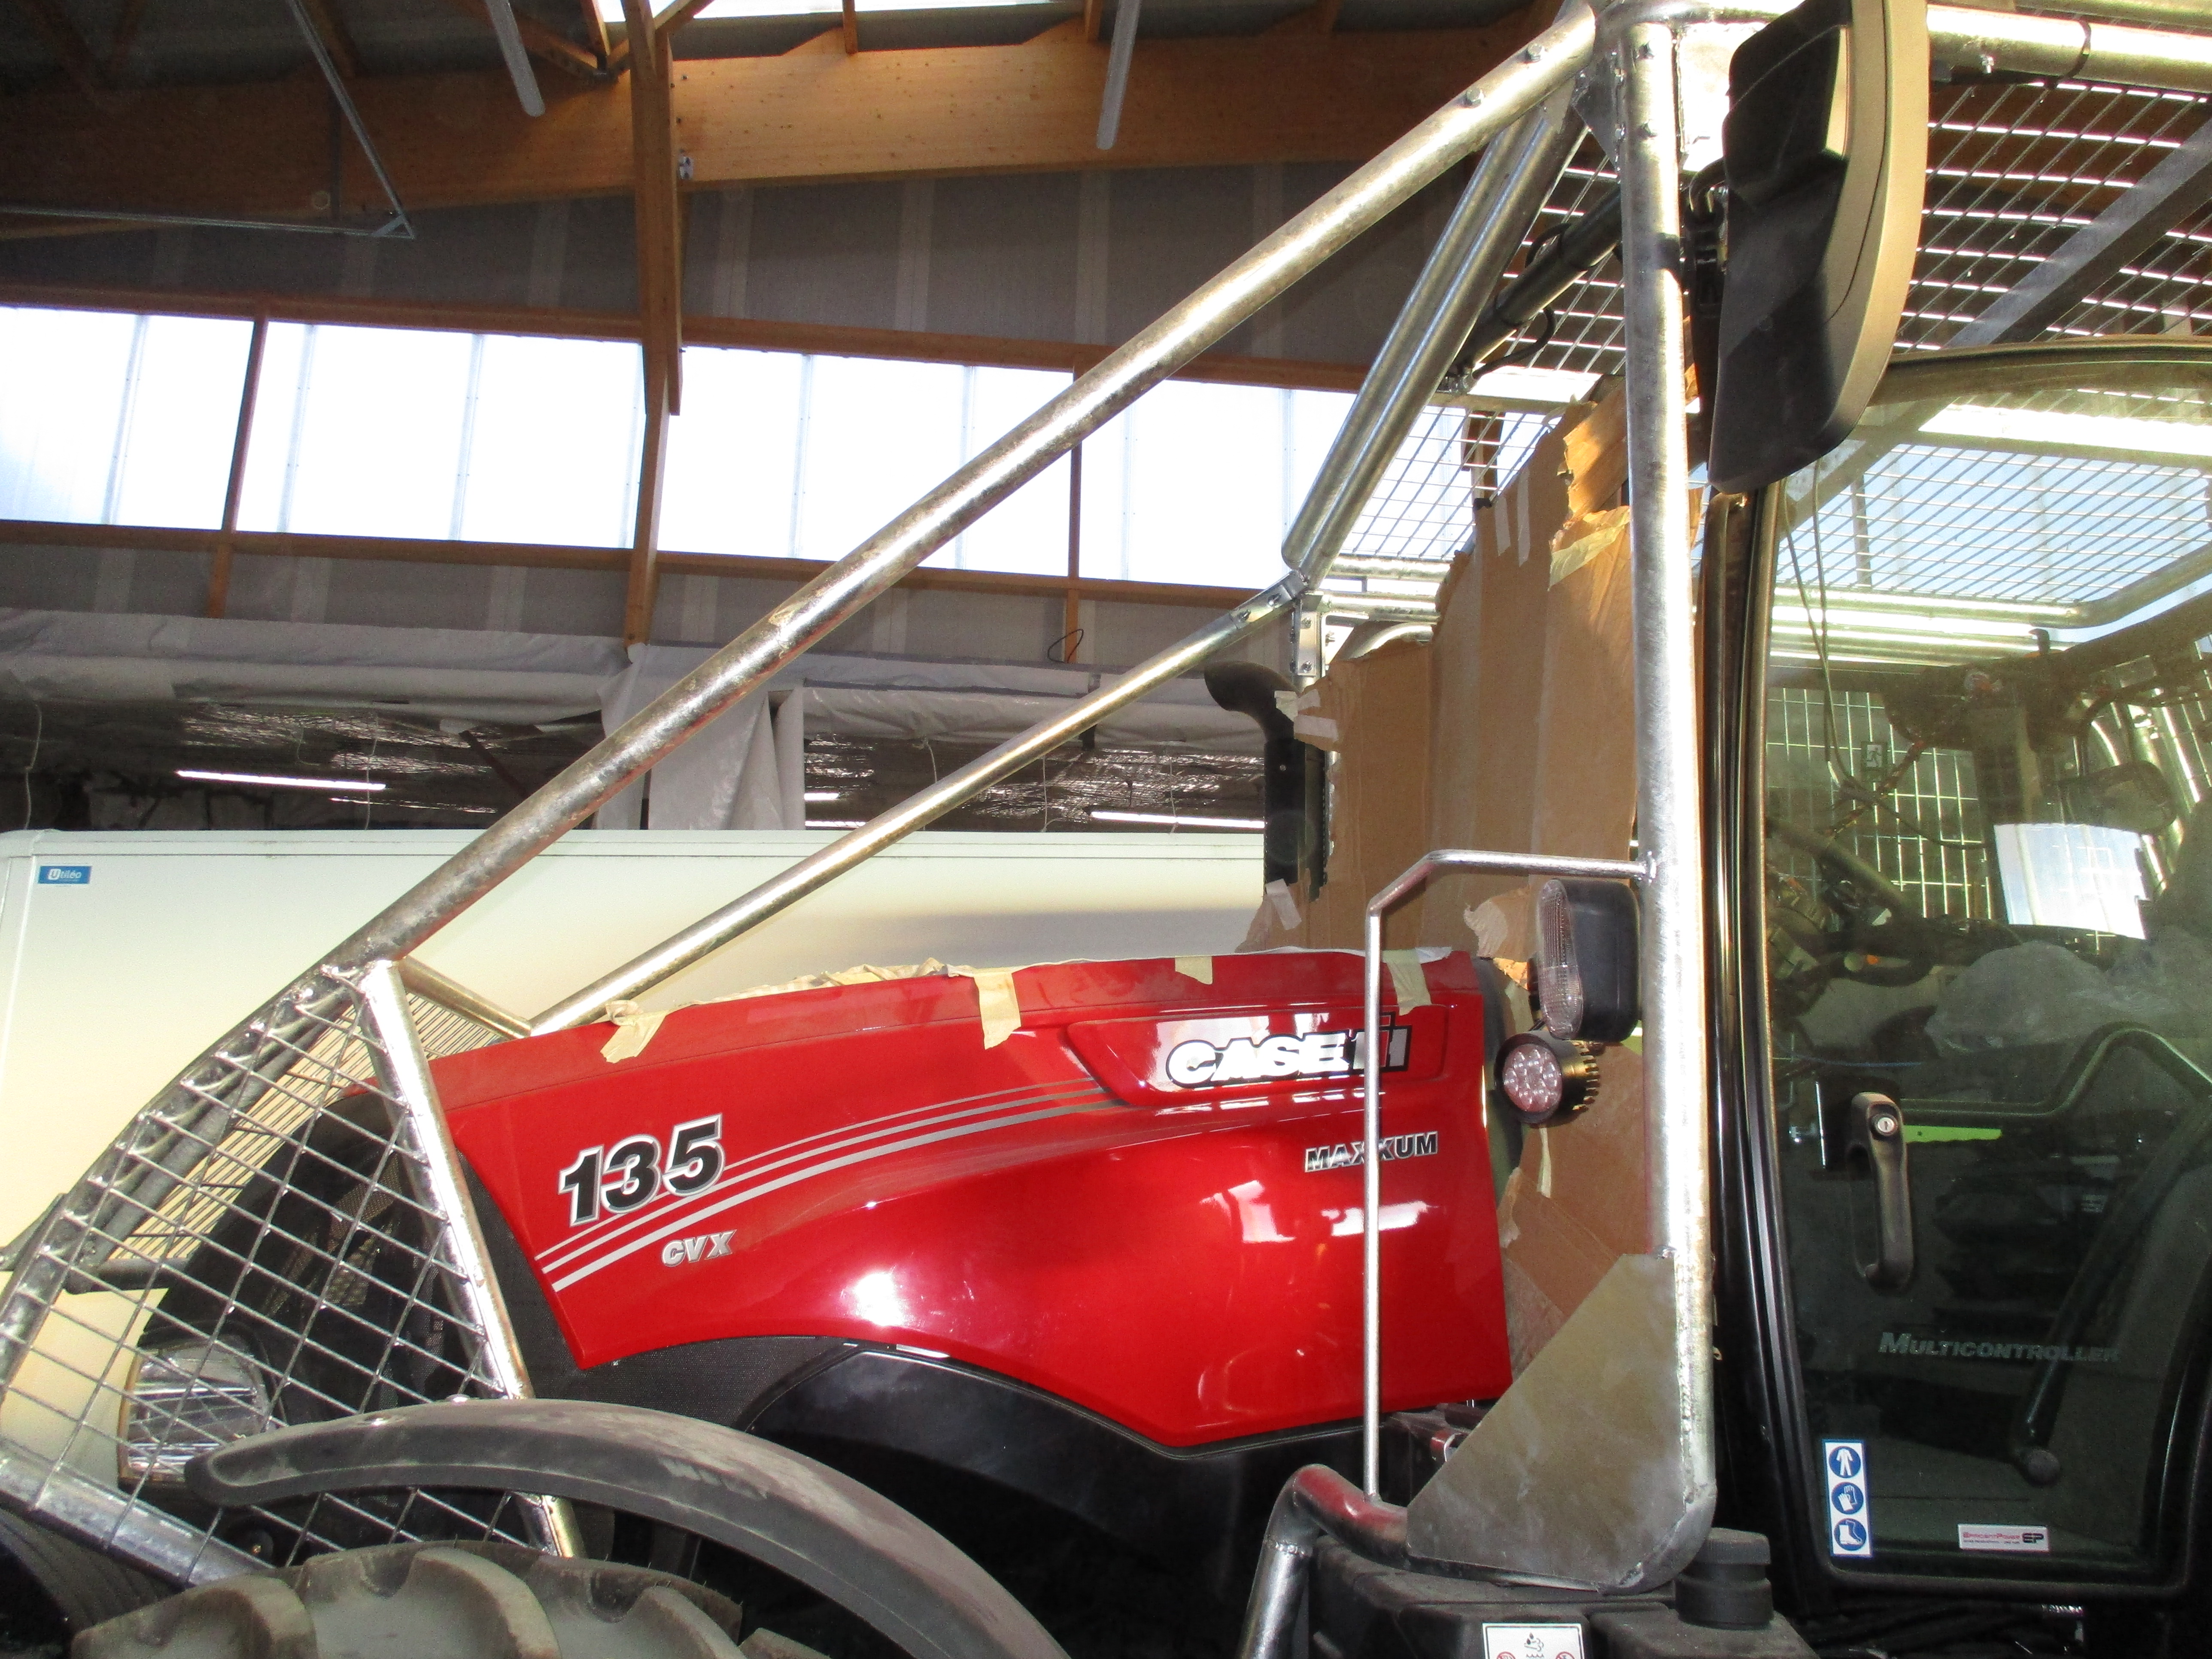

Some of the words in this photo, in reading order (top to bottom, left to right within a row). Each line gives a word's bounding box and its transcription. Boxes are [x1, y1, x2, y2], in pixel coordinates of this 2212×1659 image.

[1166, 1029, 1351, 1088] CASE
[558, 1113, 726, 1227] 135
[1305, 1131, 1438, 1173] MAXXUM
[662, 1230, 737, 1267] CVX
